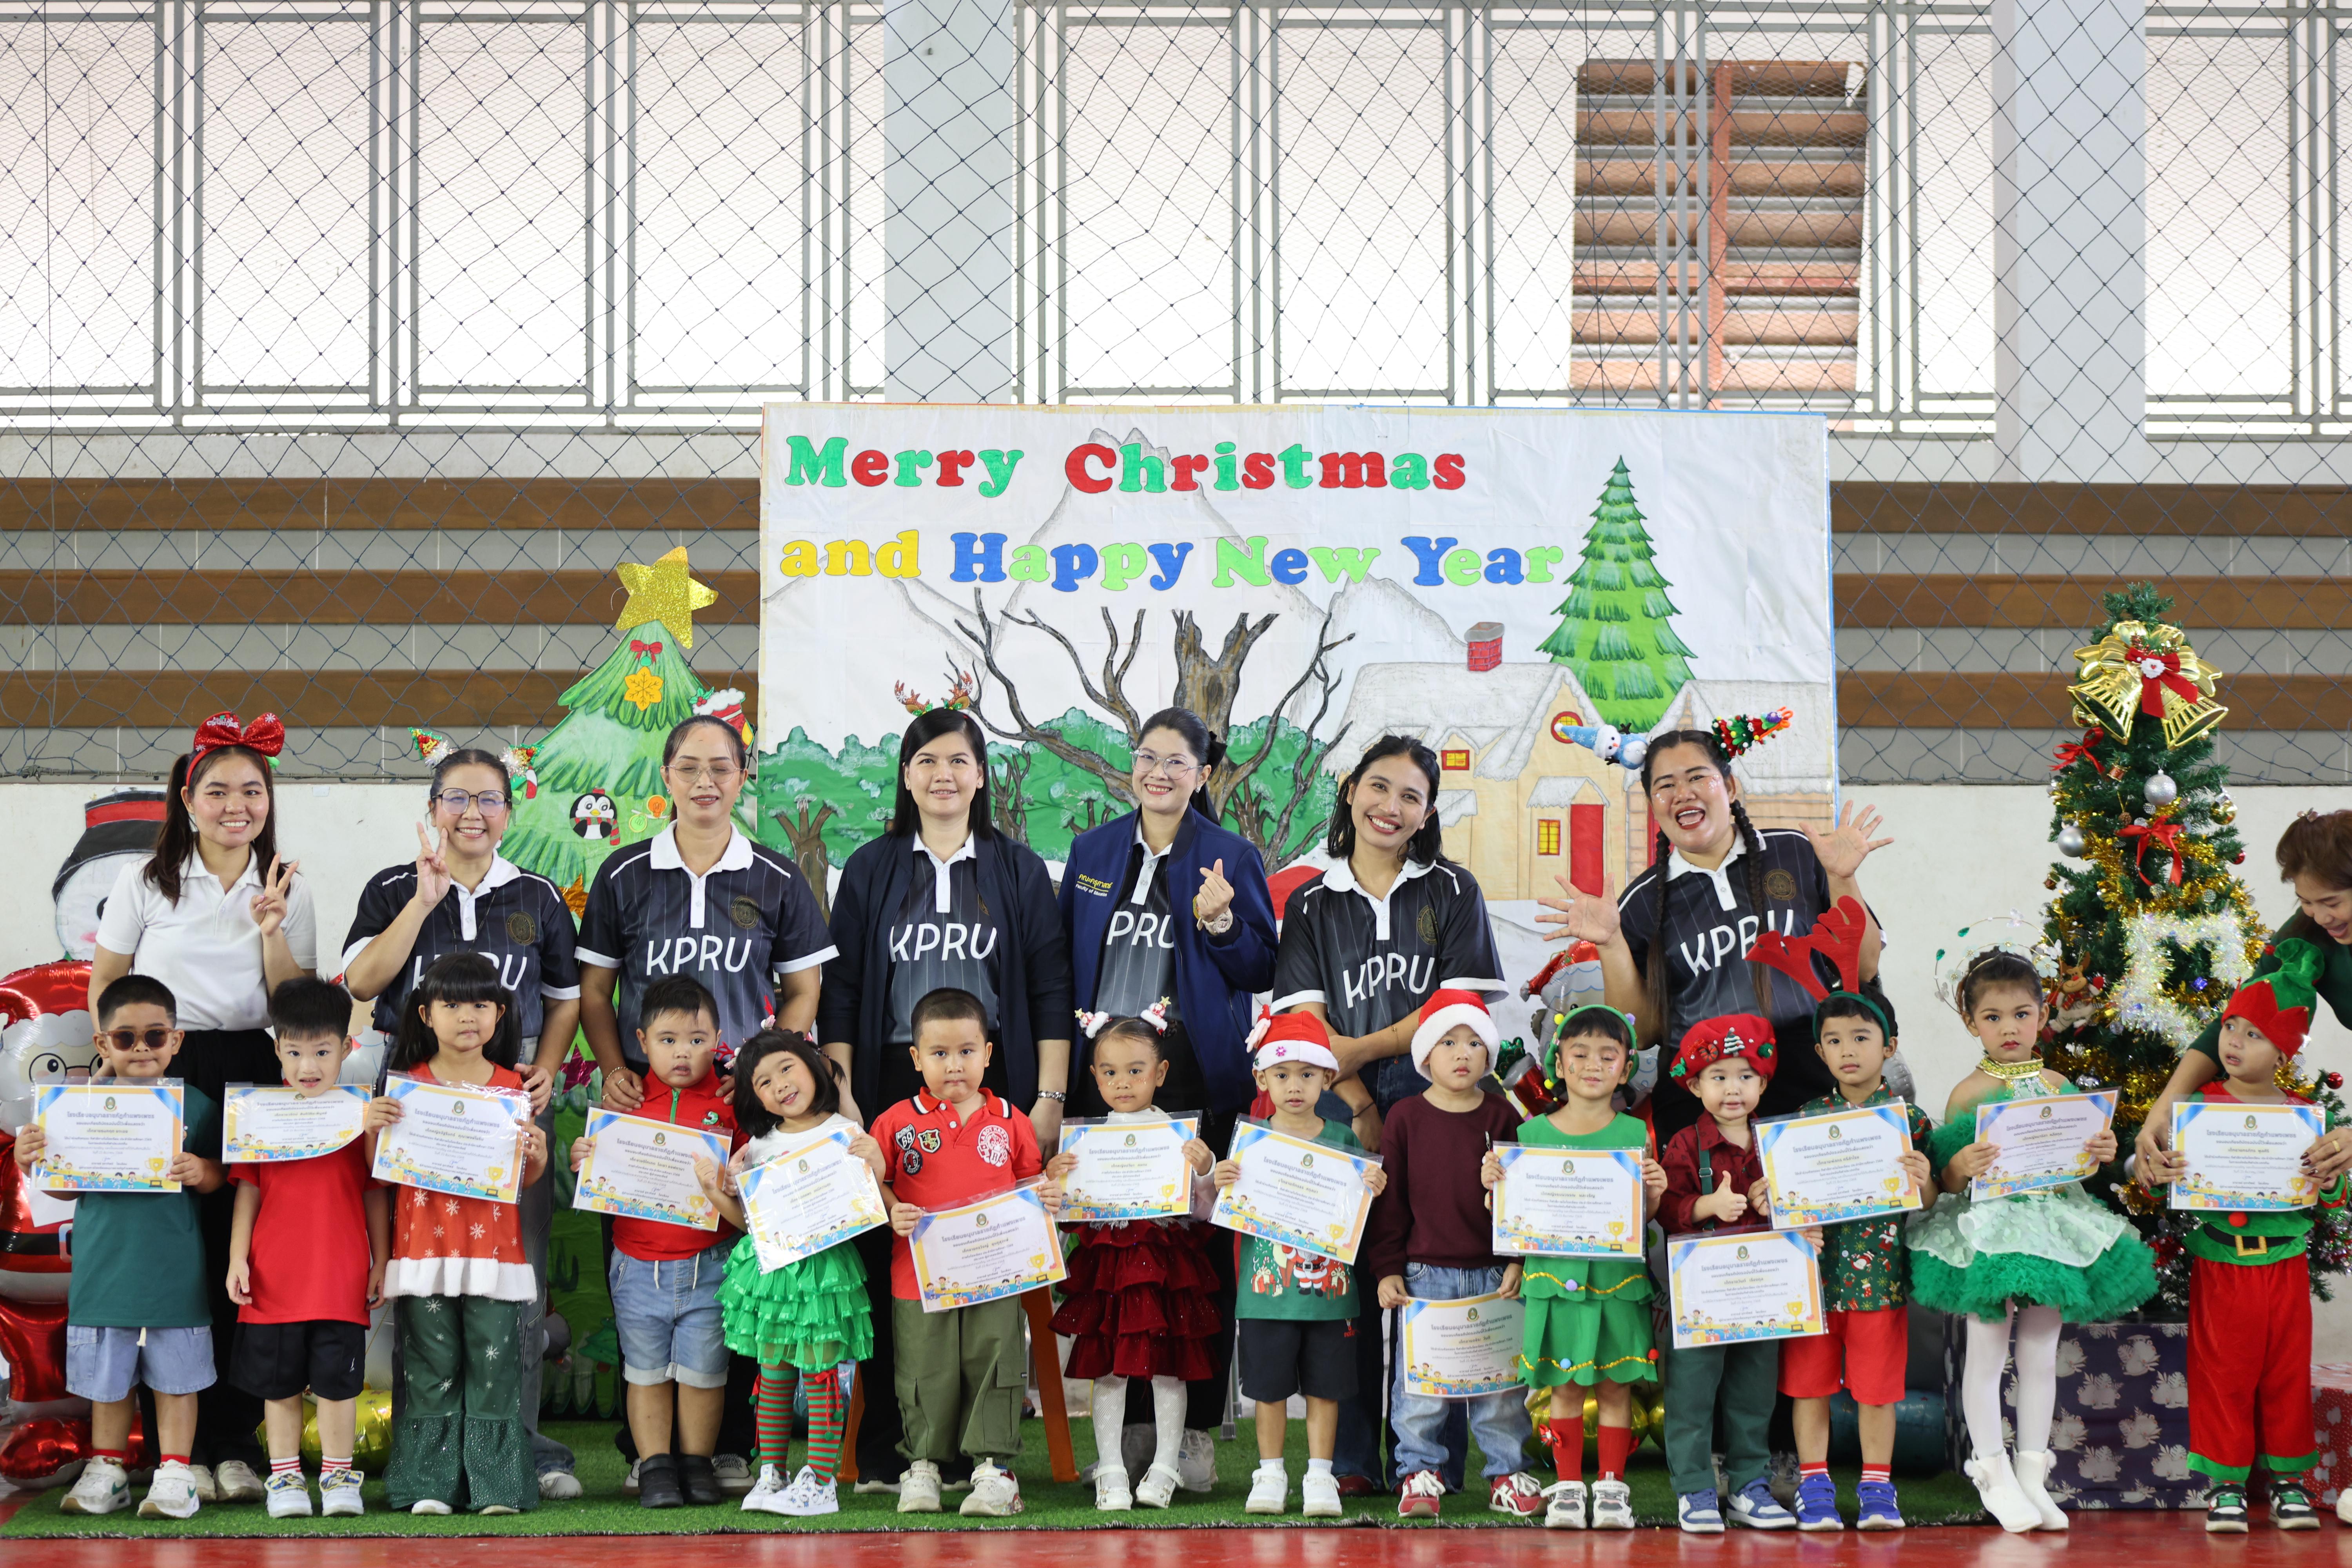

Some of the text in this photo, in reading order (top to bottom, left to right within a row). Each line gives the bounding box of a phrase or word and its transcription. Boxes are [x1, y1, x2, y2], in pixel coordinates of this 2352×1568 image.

[784, 435, 1466, 498] Merry Christmas
[780, 530, 1564, 592] and Happy New Year
[1075, 884, 1089, 892] Faculty
[1078, 874, 1113, 889] คณะครุศาสตร์
[889, 923, 997, 962] KPRU
[646, 935, 752, 976] KPRU
[1343, 953, 1435, 1009] KPRU
[902, 1132, 913, 1148] 69
[982, 1127, 992, 1136] BOY
[993, 1127, 1007, 1143] HAPPY
[1793, 1135, 1881, 1153] โรงเรียนอนุบาลราชภัฏกำแพงเพชร
[1701, 1258, 1788, 1271] โรงเรียนอนุบาลราชภัฏกำแพงเพชร
